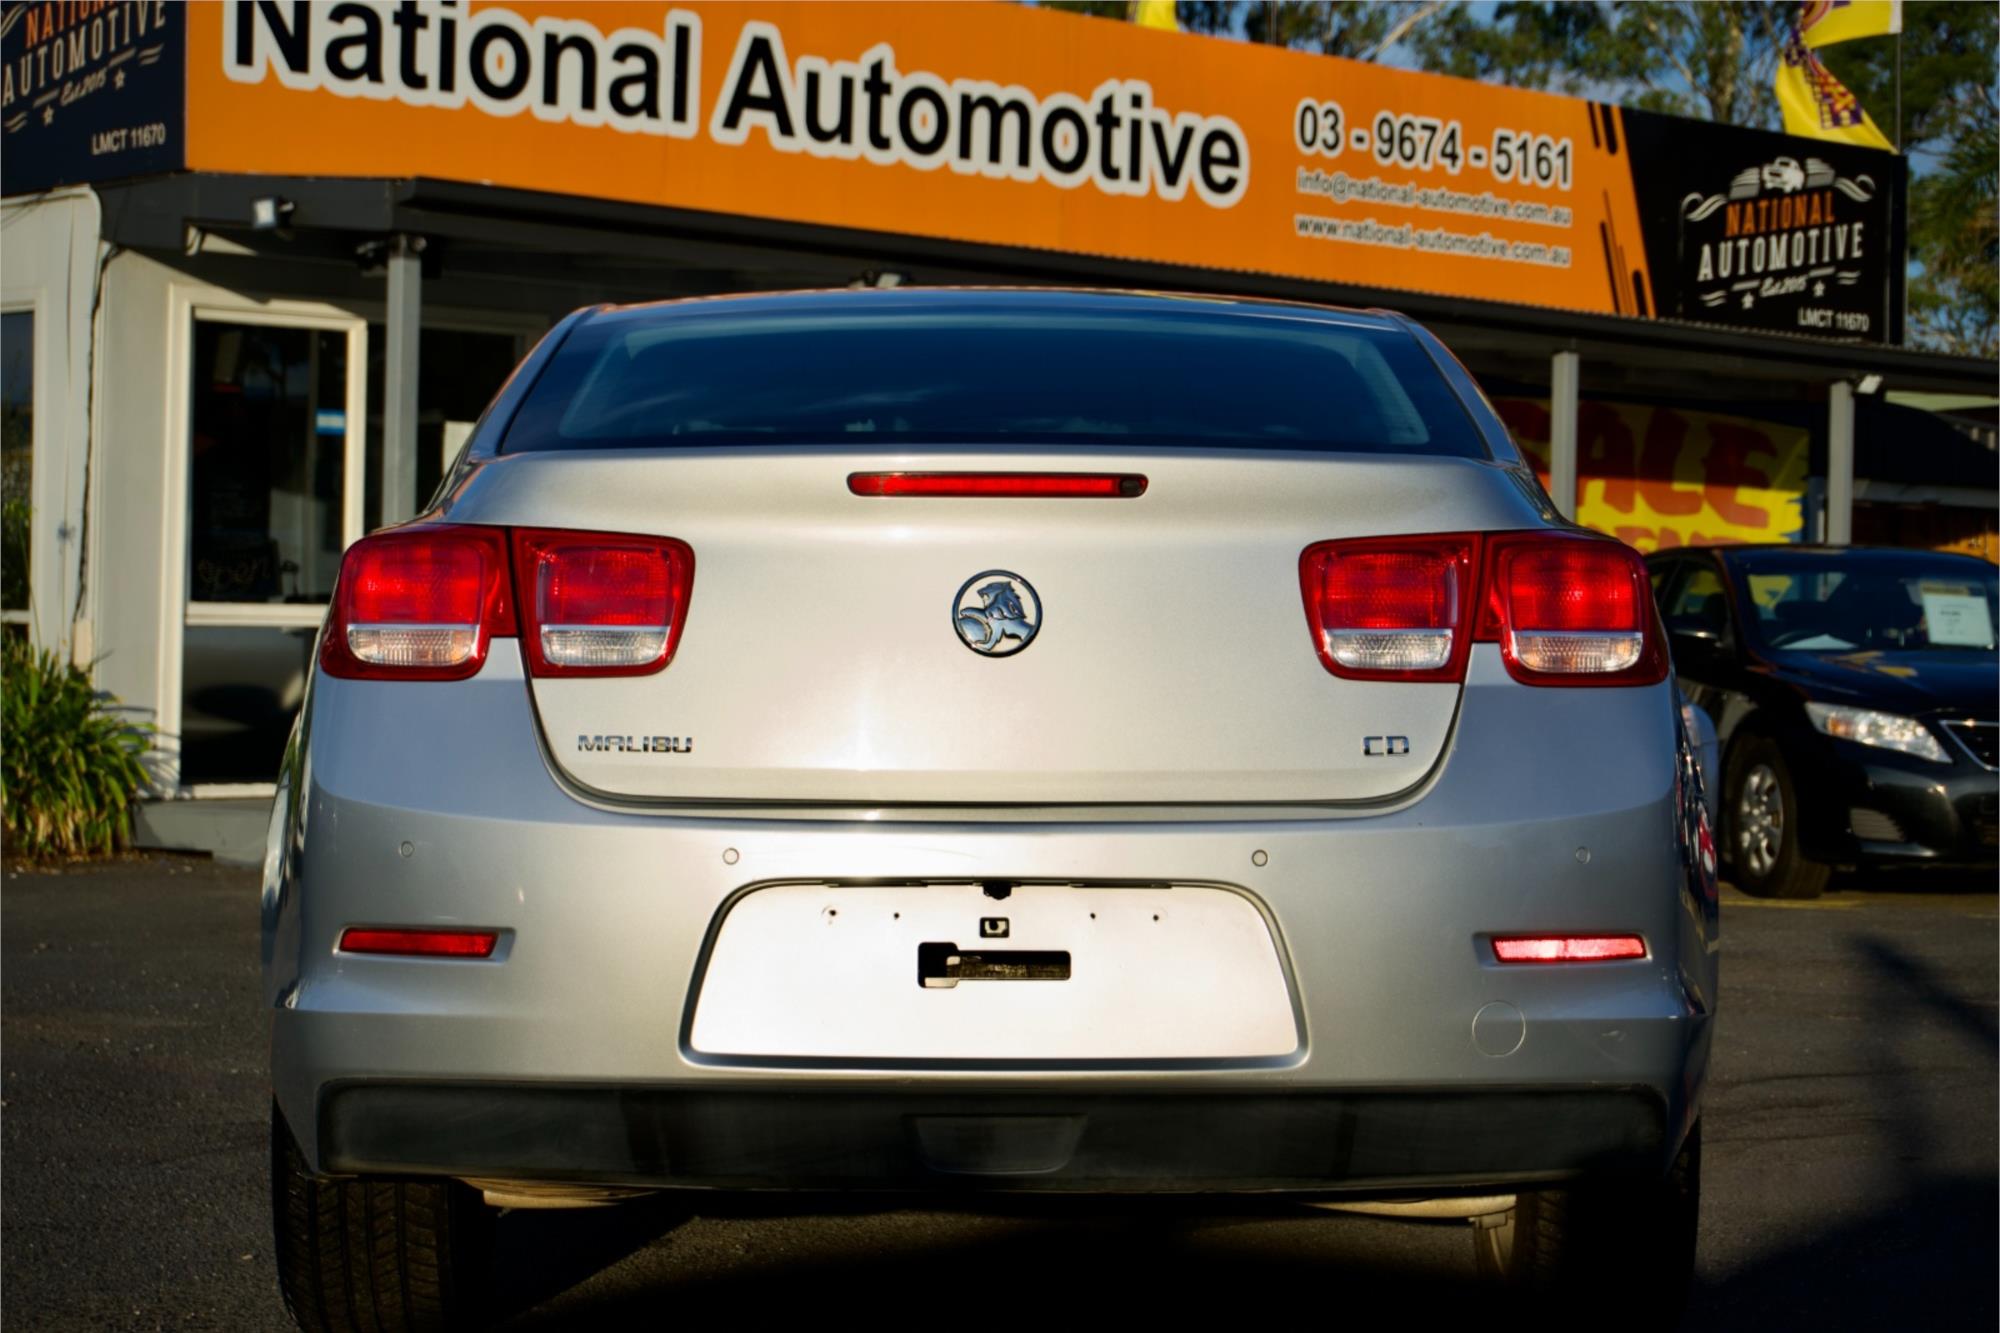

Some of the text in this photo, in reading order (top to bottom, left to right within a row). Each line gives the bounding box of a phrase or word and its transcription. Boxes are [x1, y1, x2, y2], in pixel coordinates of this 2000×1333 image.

[26, 0, 118, 48] NATIO
[1, 0, 166, 107] AUTOMOTIVE
[234, 0, 1242, 195] National Automotive
[91, 123, 166, 155] LMCT 11670
[1299, 104, 1341, 151] 03
[1376, 116, 1460, 169] 9674
[1494, 135, 1570, 184] 5161
[1725, 191, 1835, 237] NATIONAL
[1296, 217, 1571, 266] www.national-automotive.com.au
[1697, 222, 1864, 281] AUTOMOTIVE
[1797, 307, 1870, 332] LMCT 11670
[578, 734, 692, 753] MALIBU
[1363, 735, 1410, 756] CD
